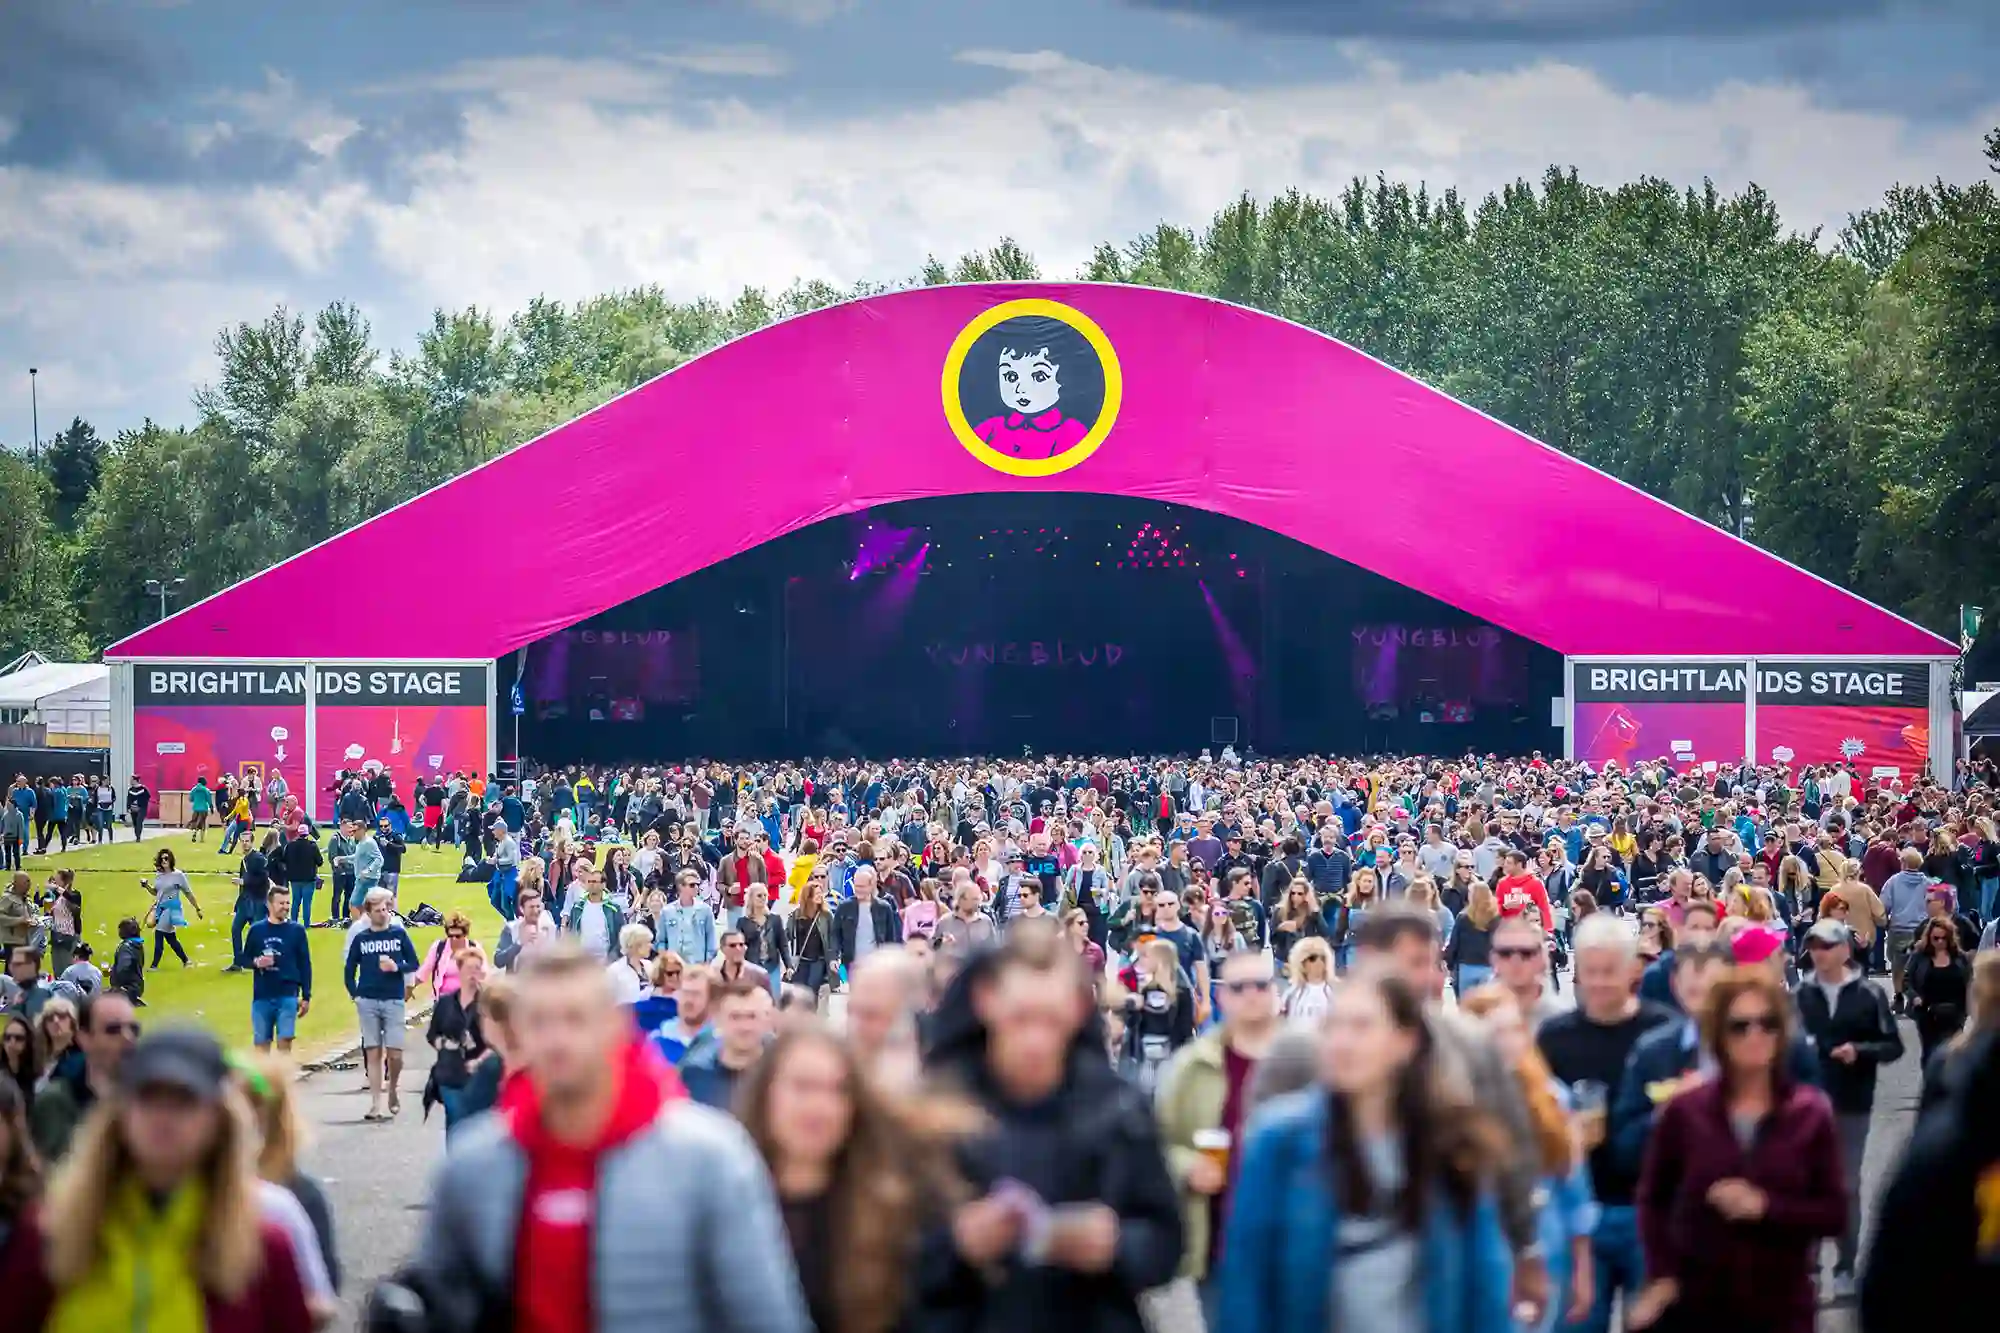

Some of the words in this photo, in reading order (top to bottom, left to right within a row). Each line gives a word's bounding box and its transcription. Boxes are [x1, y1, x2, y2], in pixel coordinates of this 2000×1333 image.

[150, 671, 361, 694] BRIGHTLANDS
[369, 671, 461, 695] STAGE
[1590, 668, 1803, 694] BRIGHTLANDS
[1810, 671, 1904, 696] STAGE
[360, 939, 401, 955] NORDIC
